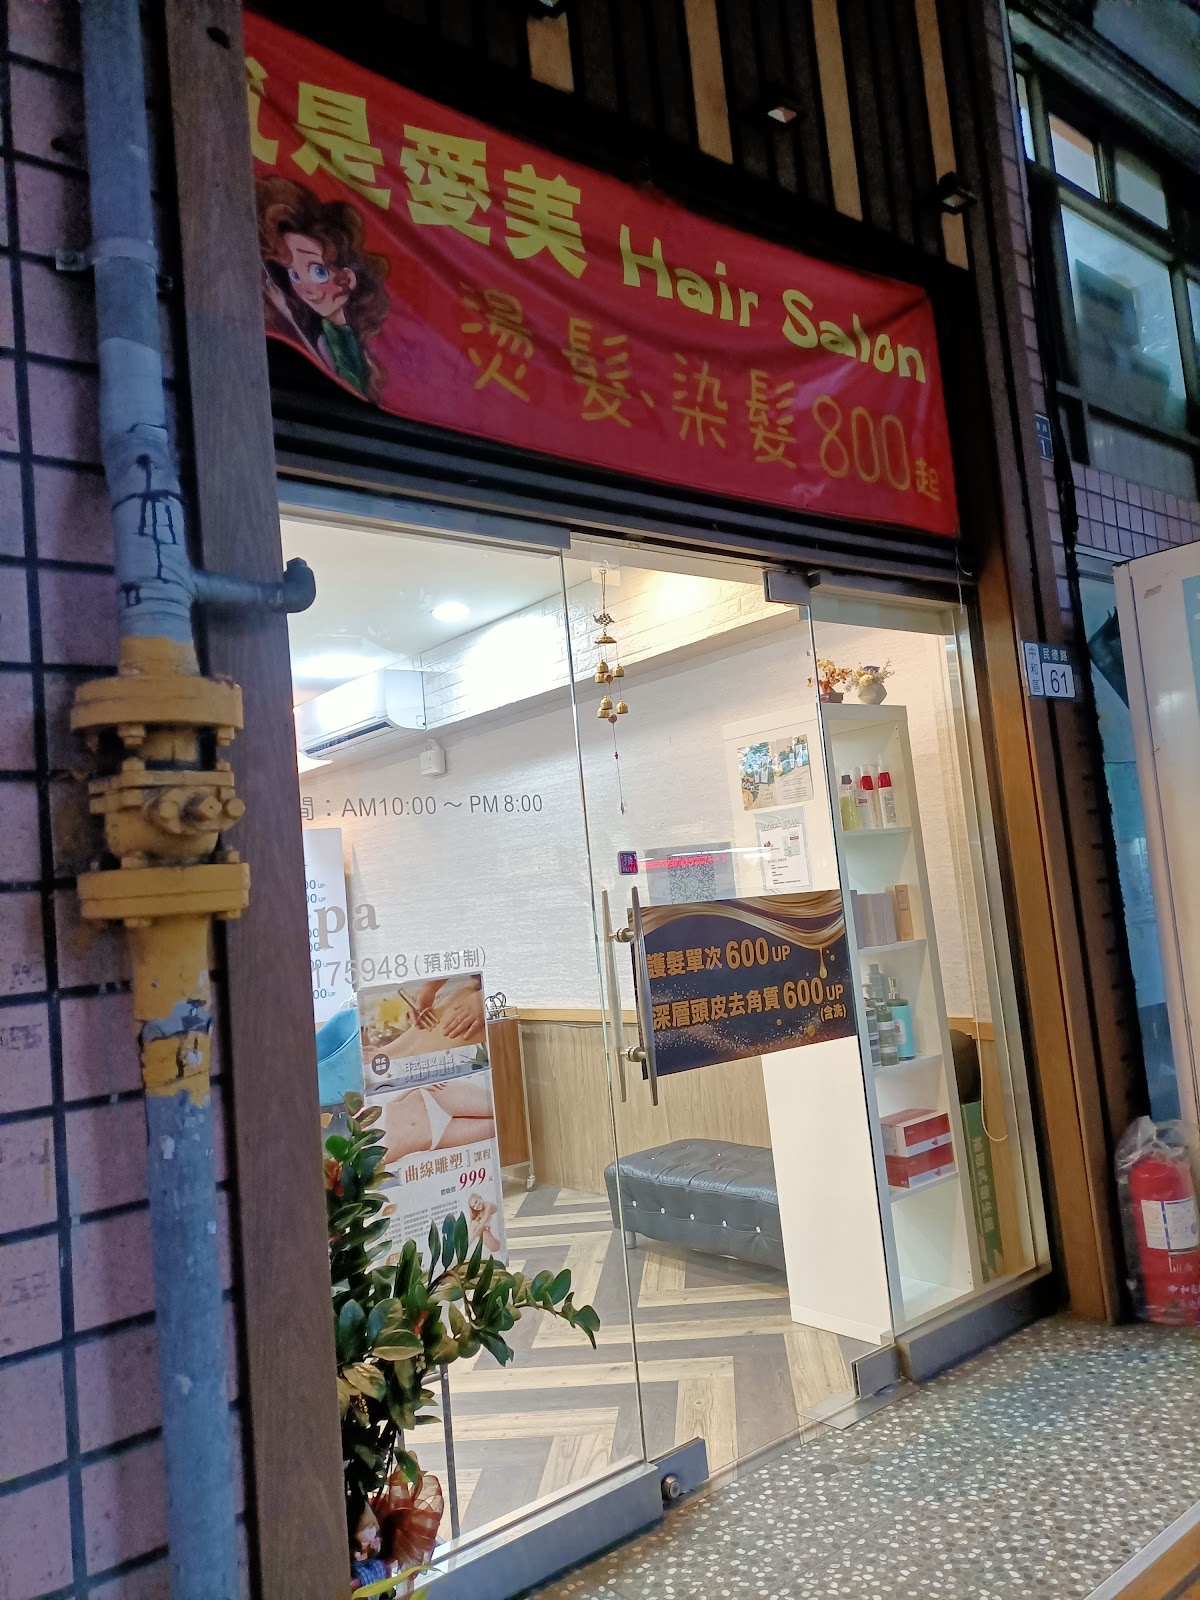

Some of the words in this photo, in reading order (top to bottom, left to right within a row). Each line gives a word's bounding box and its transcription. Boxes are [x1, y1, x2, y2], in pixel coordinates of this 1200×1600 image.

[618, 223, 759, 327] Hair
[781, 288, 926, 384] Salon
[1042, 647, 1068, 662] 民德路
[1028, 646, 1042, 693] 中和區
[1050, 669, 1068, 694] 61
[459, 1167, 487, 1191] 999
